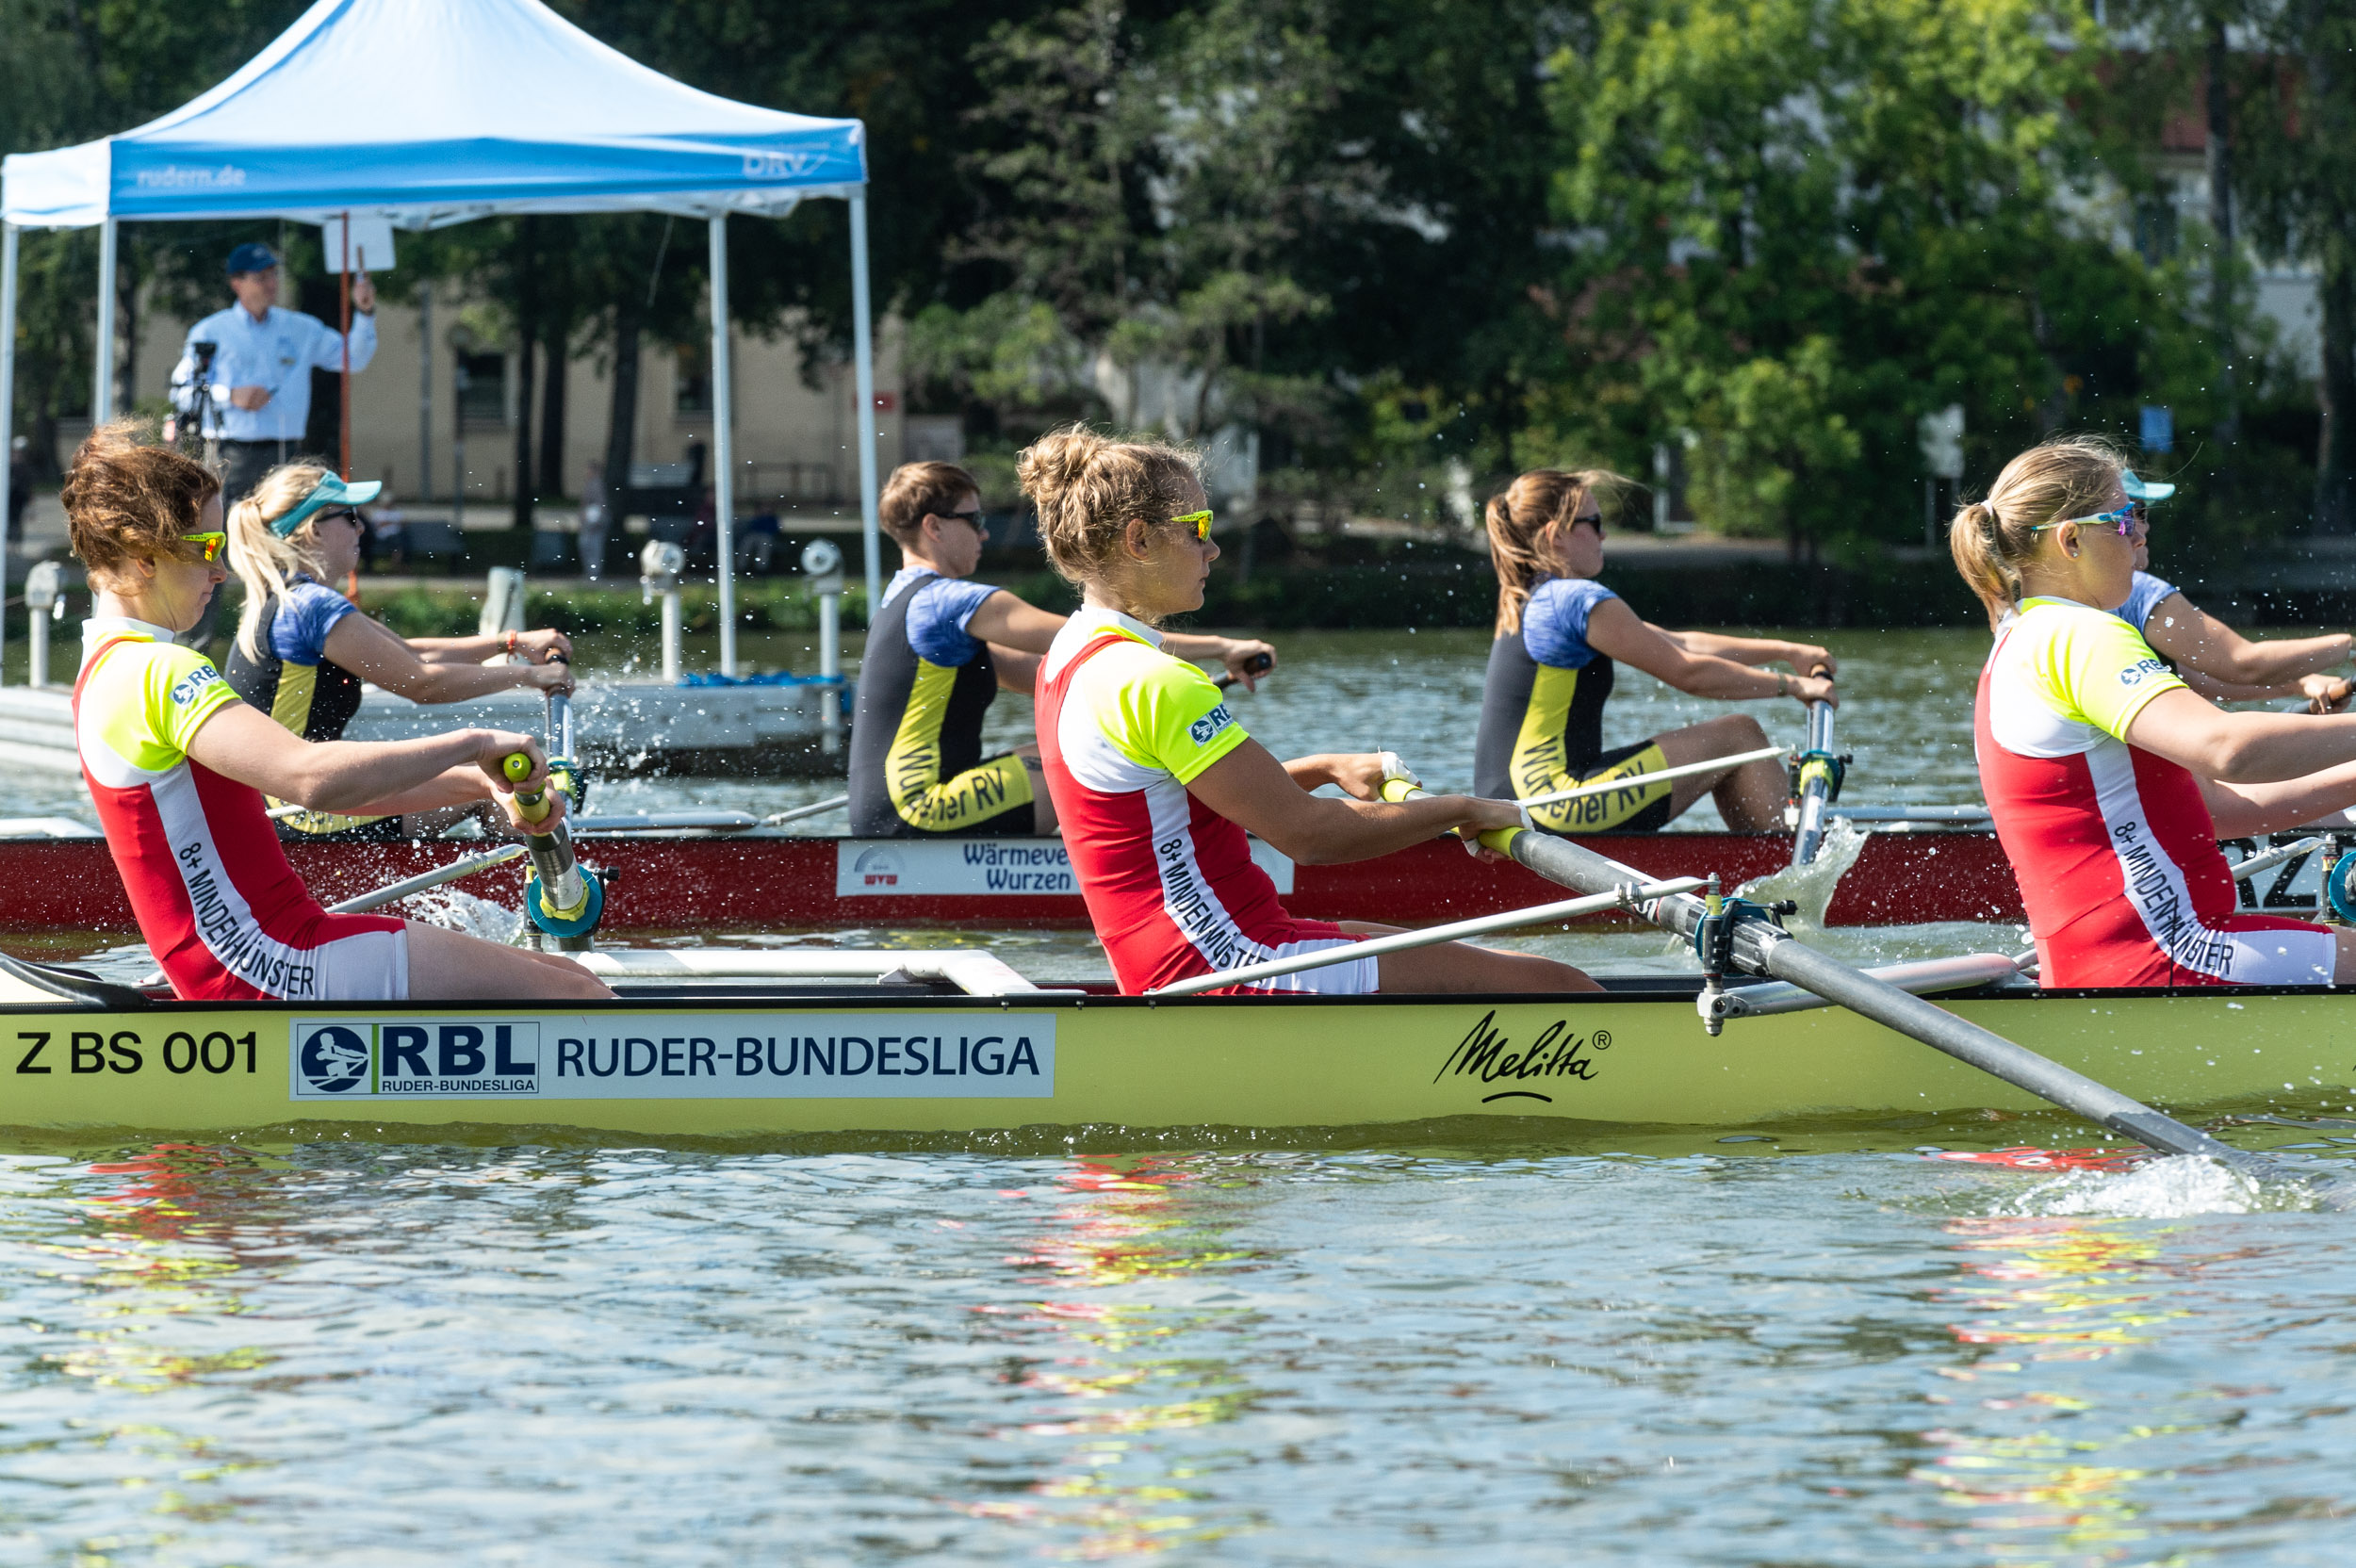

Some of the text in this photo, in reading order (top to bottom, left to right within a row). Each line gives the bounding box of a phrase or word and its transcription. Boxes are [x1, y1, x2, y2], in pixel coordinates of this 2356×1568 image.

[137, 164, 247, 188] rudern.de
[972, 766, 1006, 810] RV
[2114, 821, 2137, 843] 8+
[179, 841, 203, 869] 8+
[1160, 838, 1183, 862] 8+
[986, 868, 1071, 890] Wurzen
[2217, 834, 2356, 908] RZ
[16, 1031, 256, 1074] Z BS 001
[382, 1024, 535, 1077] RBL
[556, 1036, 1040, 1077] RUDER-BUNDESLIGA
[382, 1079, 535, 1092] RUDER-BUNDESLIGA
